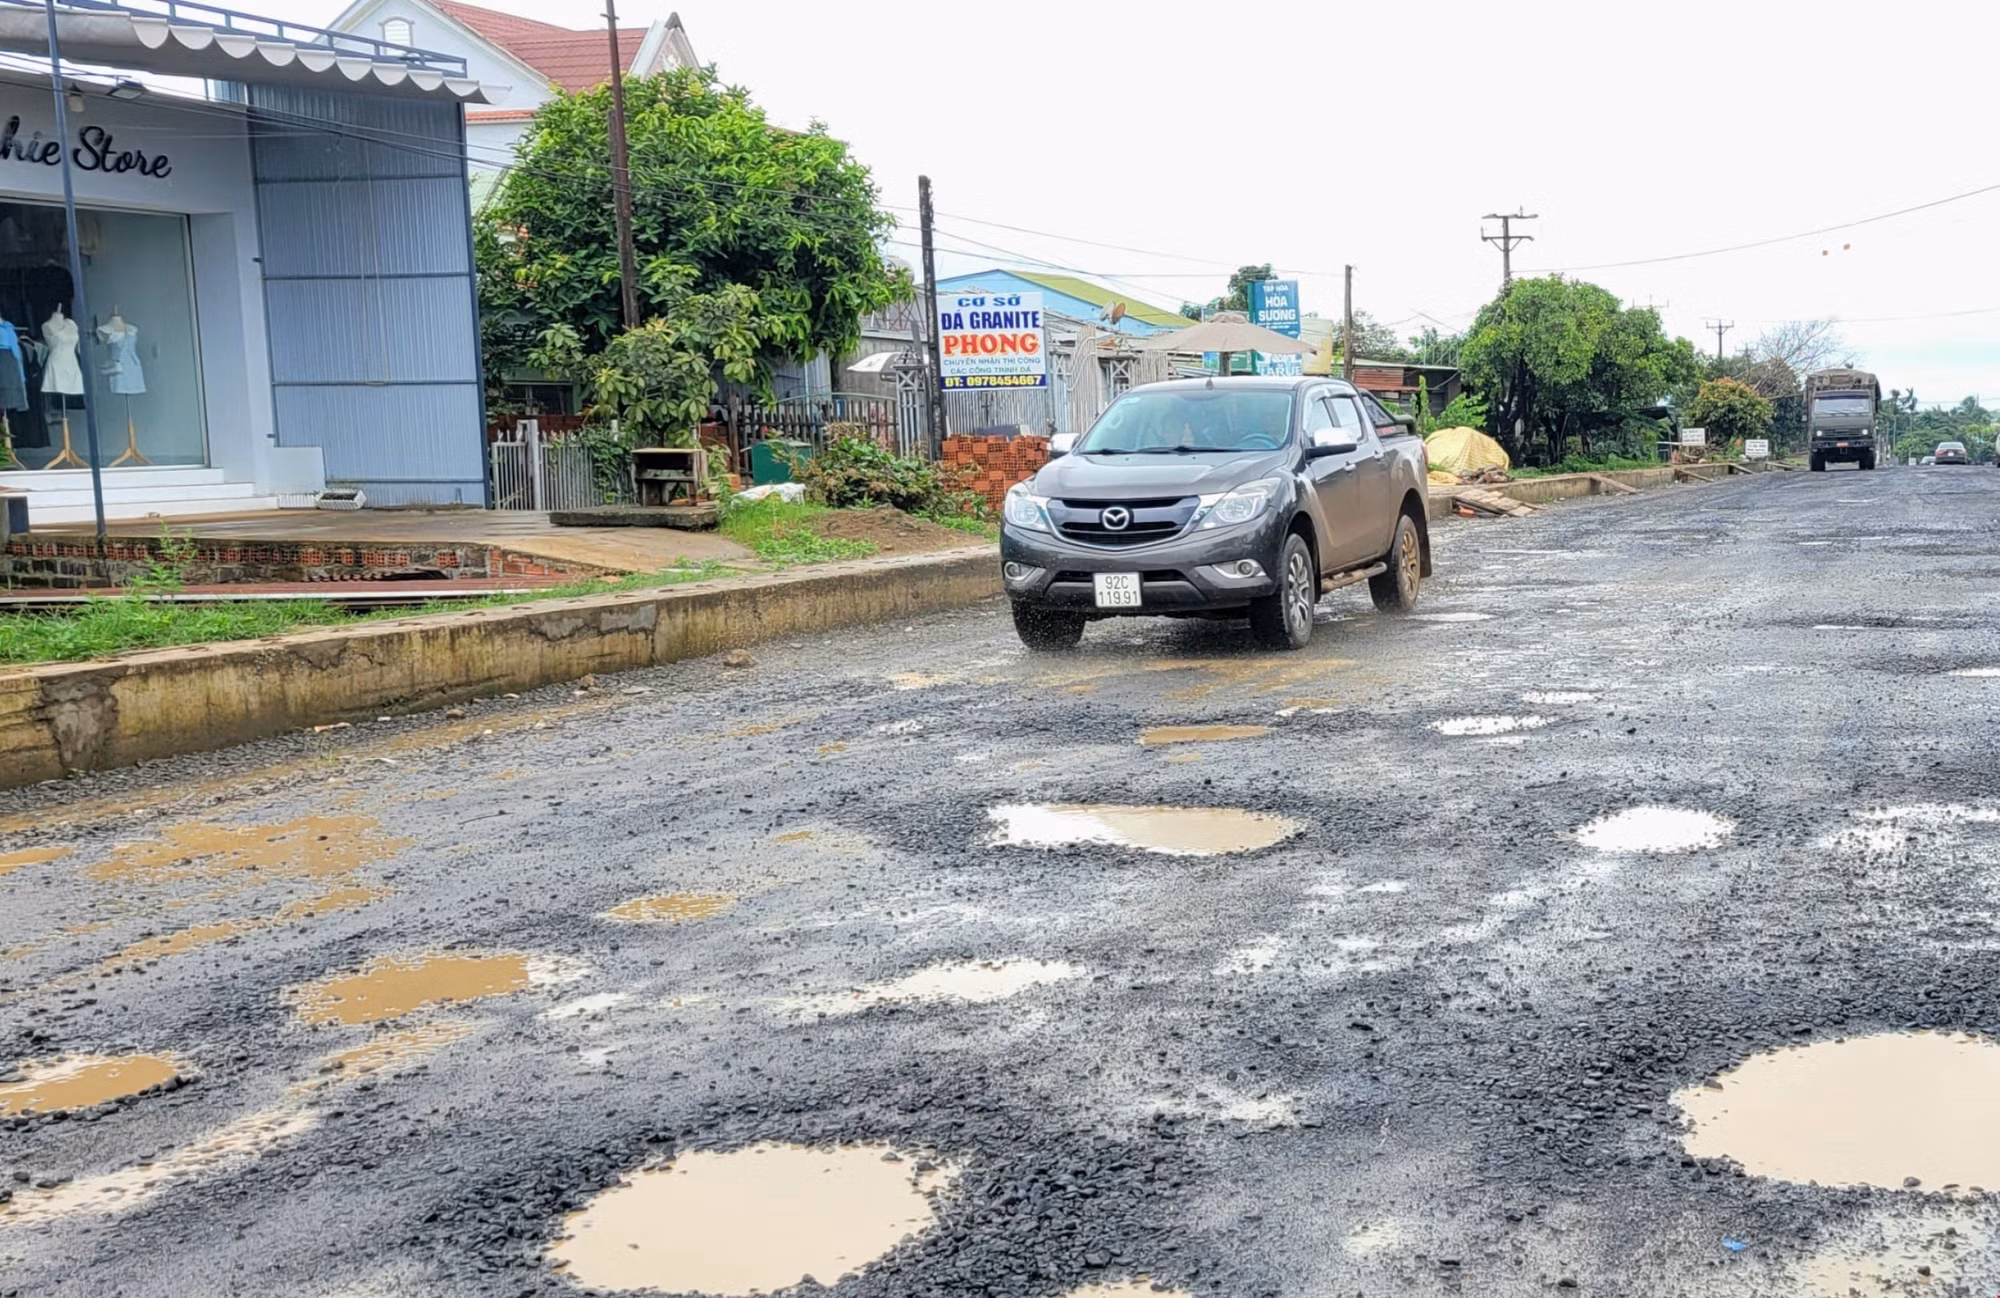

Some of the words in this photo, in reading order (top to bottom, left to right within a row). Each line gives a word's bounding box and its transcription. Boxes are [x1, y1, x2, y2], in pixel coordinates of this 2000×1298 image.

[73, 126, 172, 178] Store
[969, 311, 1040, 329] GRANITE
[942, 332, 1040, 356] PHONG
[1105, 575, 1129, 590] 92C
[1098, 591, 1139, 605] 119.91
